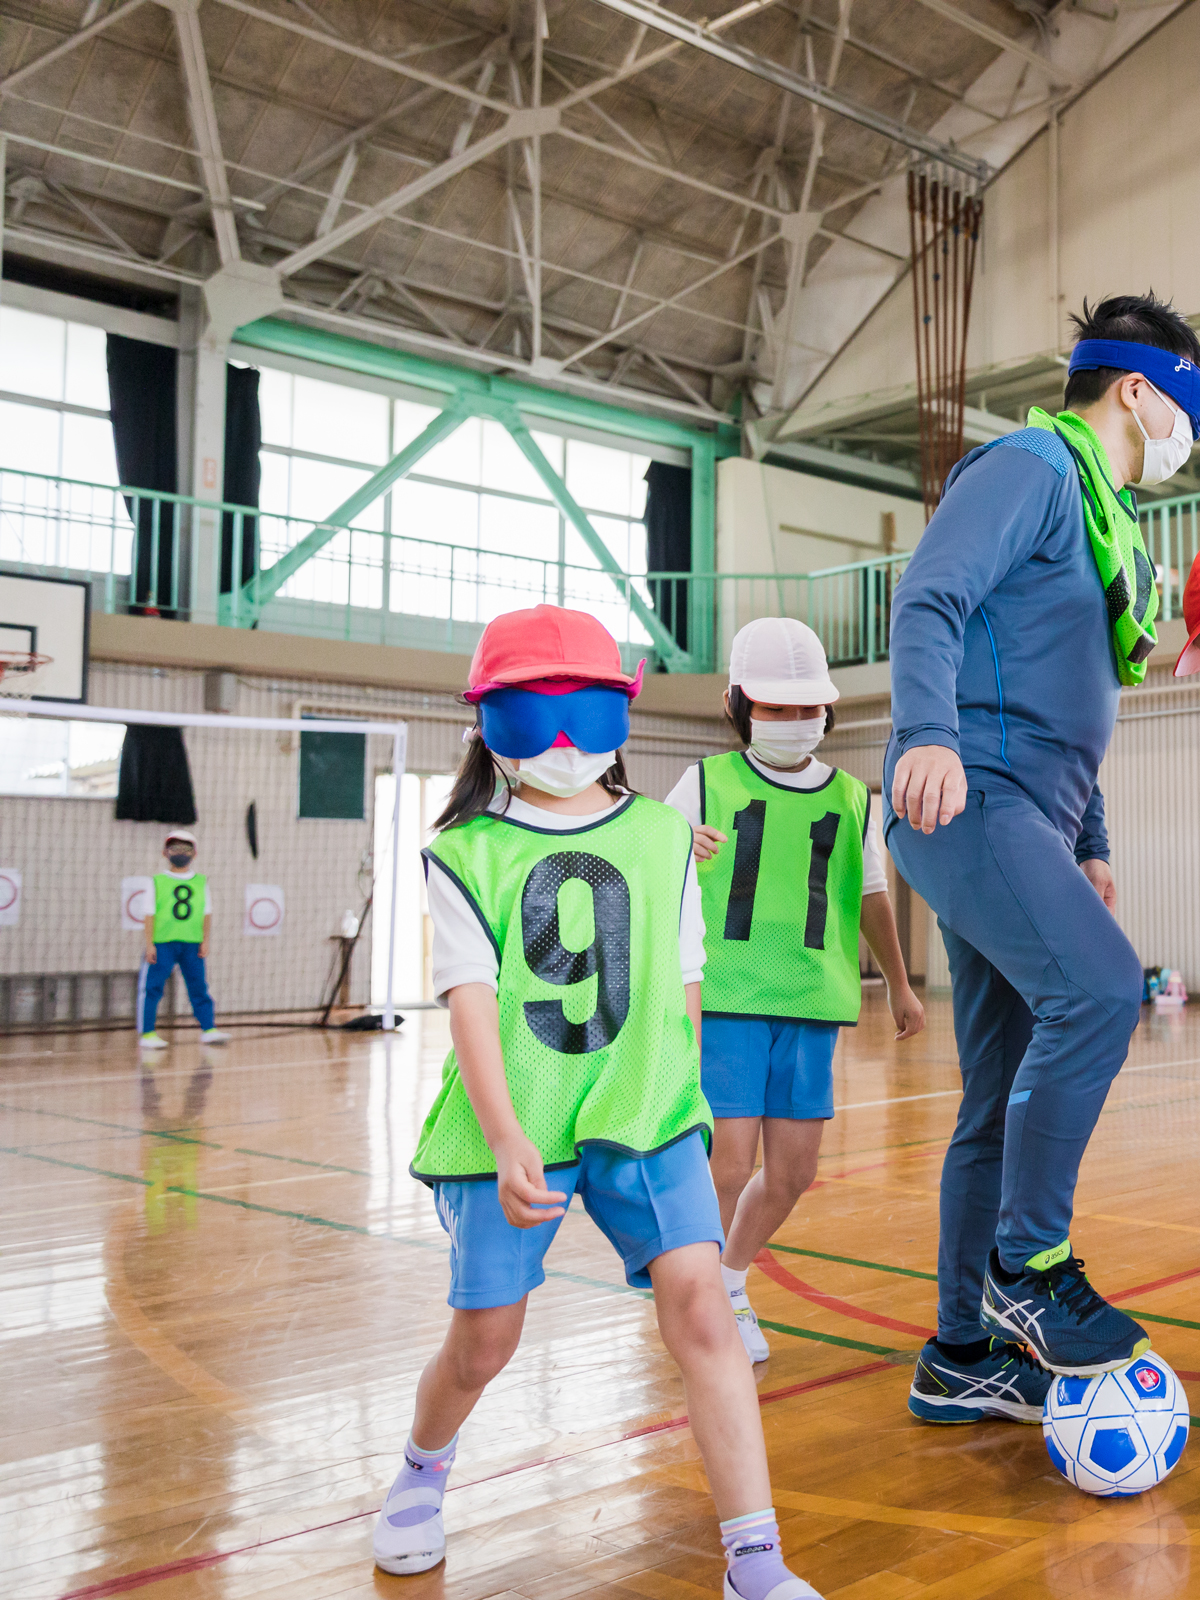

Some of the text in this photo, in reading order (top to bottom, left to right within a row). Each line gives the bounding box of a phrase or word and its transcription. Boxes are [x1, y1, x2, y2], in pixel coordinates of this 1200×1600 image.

[173, 885, 192, 921] 8
[723, 798, 841, 951] 11
[521, 851, 631, 1055] 9
[1051, 1249, 1064, 1260] asics
